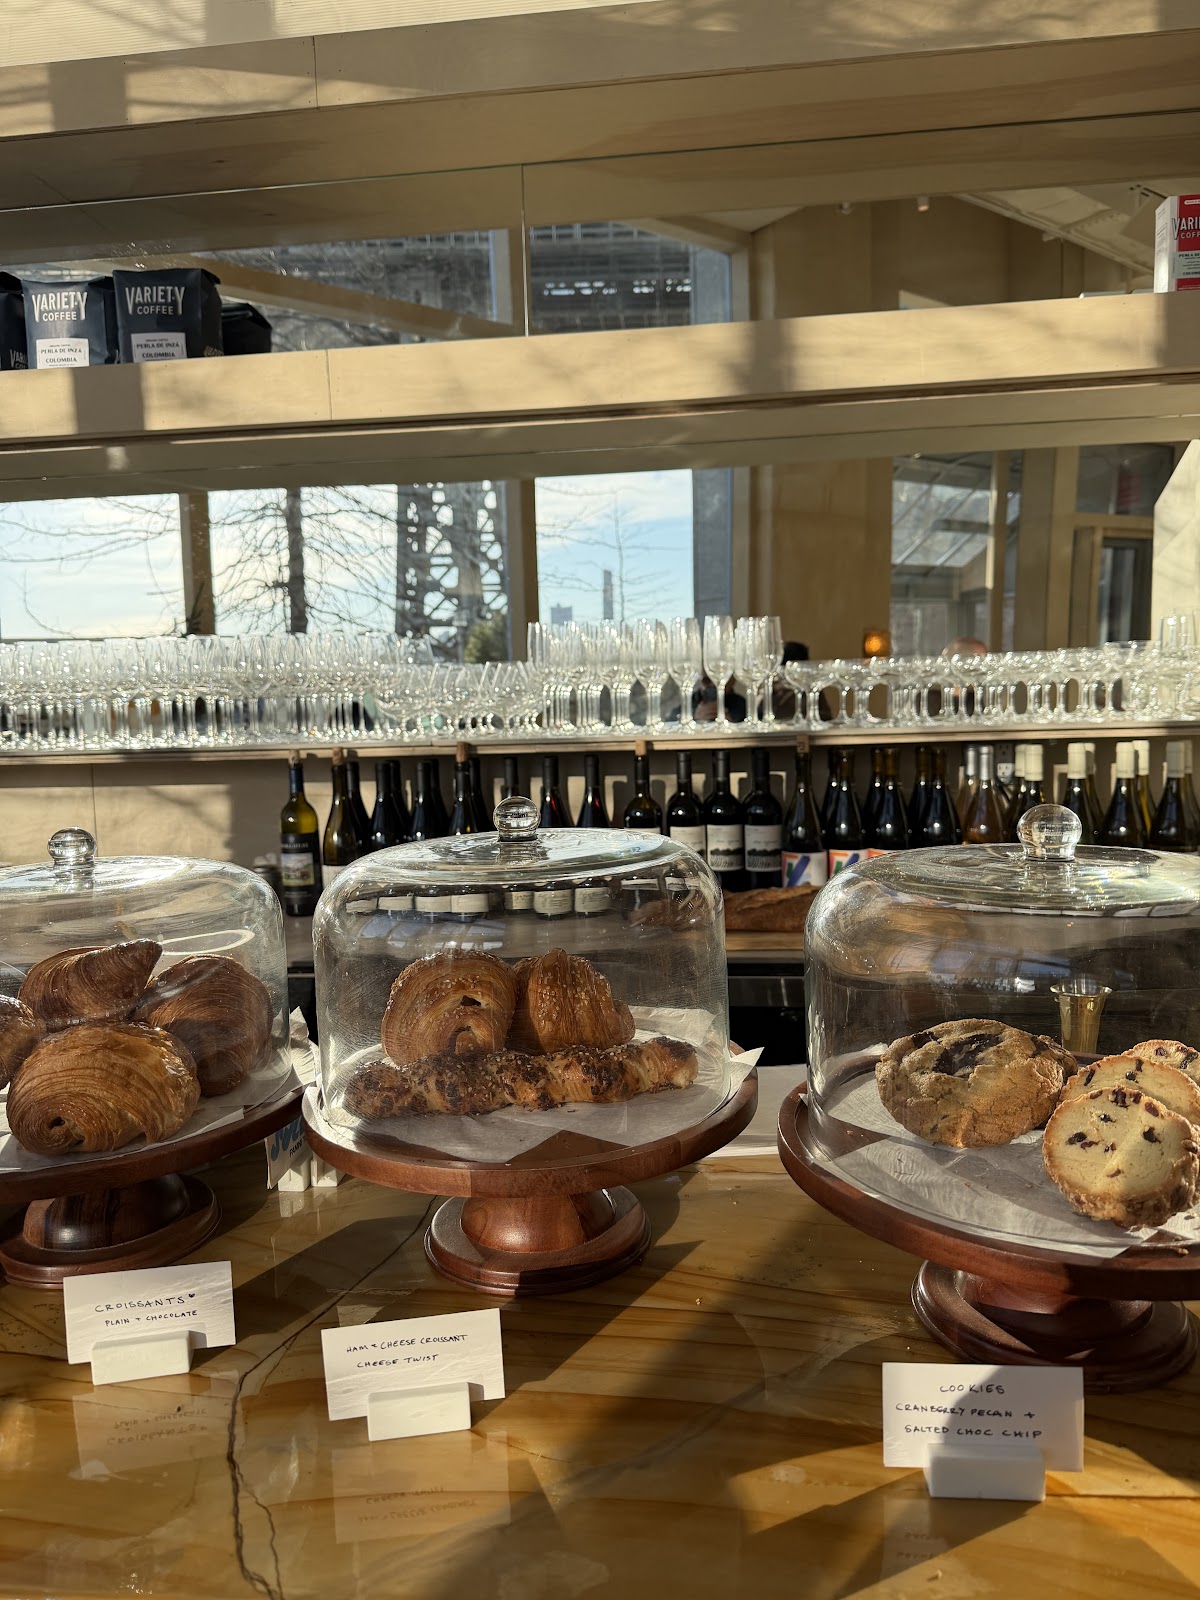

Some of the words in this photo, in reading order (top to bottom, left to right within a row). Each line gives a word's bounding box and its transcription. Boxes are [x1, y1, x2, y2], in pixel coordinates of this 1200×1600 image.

[1172, 216, 1200, 240] VARI
[32, 291, 88, 323] VARIETY
[125, 286, 185, 316] VARIETY
[42, 312, 78, 323] COFFEE
[137, 305, 174, 316] COFFEE
[94, 1296, 185, 1313] CROISSANTS
[104, 1318, 130, 1327] PLAIN
[145, 1310, 198, 1321] CHOCOLATE
[346, 1344, 369, 1353] HAM
[380, 1338, 417, 1350] CHEESE
[420, 1333, 468, 1345] CROISSANT
[356, 1358, 399, 1368] CHEESE
[403, 1353, 440, 1364] TWIST
[895, 1402, 966, 1417] CRANBERRY
[970, 1408, 1013, 1417] PECAN
[904, 1424, 950, 1434] SALTED
[956, 1428, 994, 1436] CHOC
[1001, 1429, 1042, 1439] CHIP
